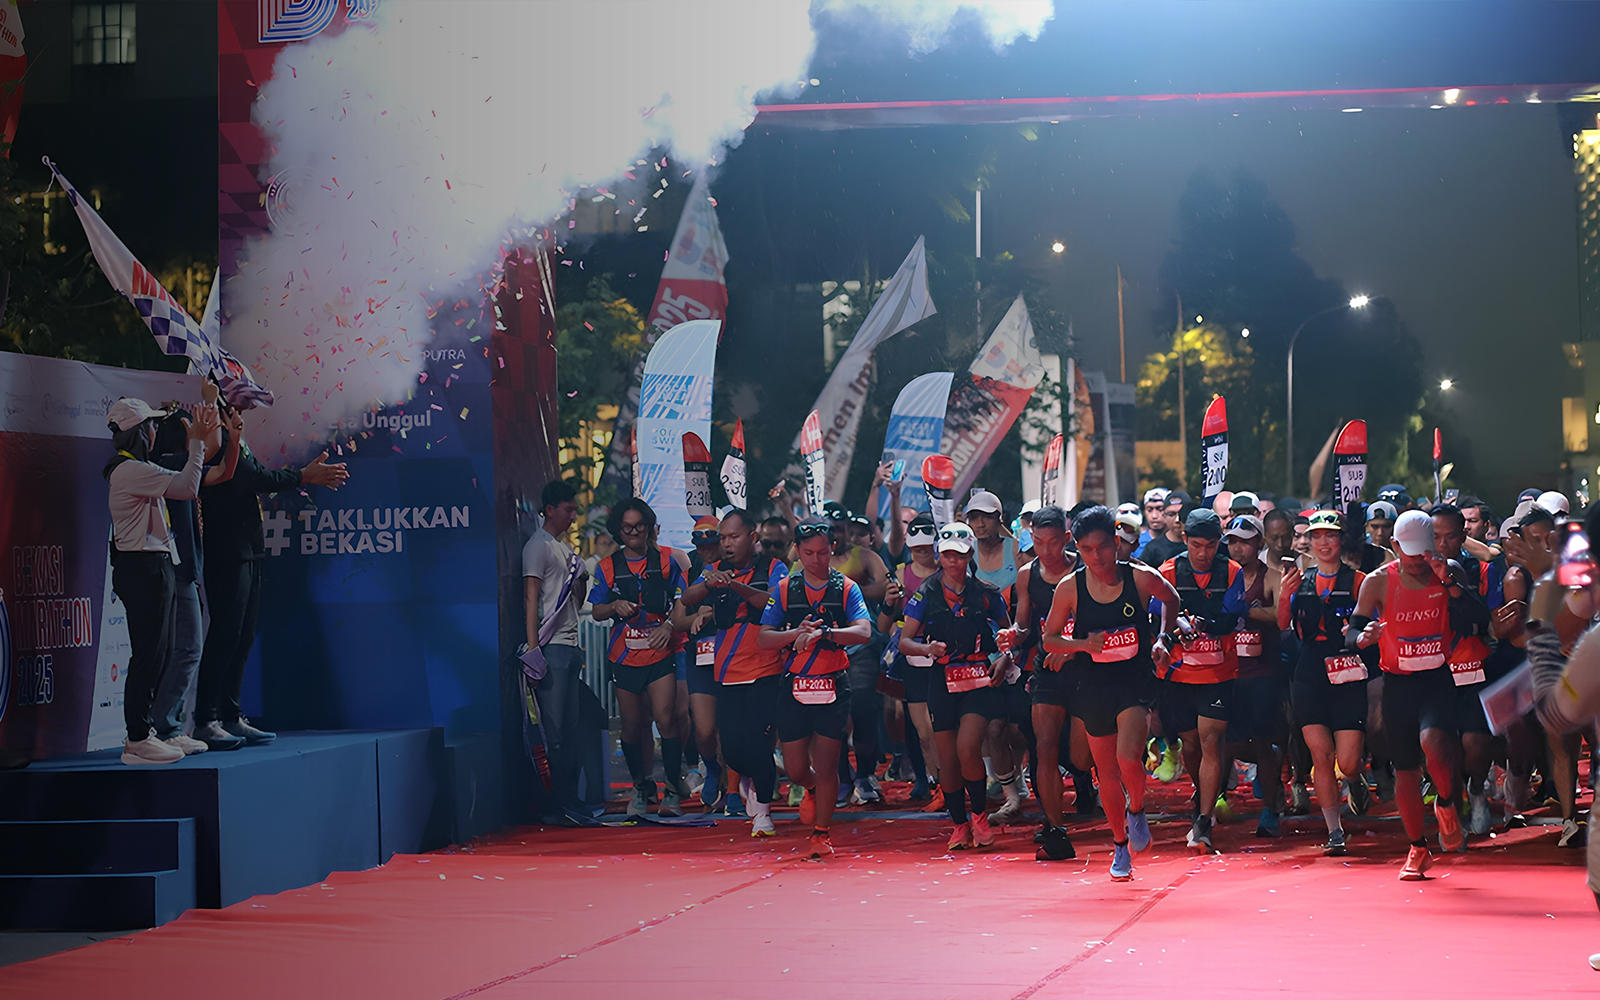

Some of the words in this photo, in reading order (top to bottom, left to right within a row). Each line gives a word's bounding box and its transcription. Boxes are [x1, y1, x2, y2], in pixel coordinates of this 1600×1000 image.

[363, 409, 431, 432] Unggul
[686, 490, 711, 507] 2:30
[300, 505, 470, 531] TAKLUKKAN
[300, 531, 403, 555] BEKASI
[1396, 607, 1440, 622] DENSO
[1104, 631, 1136, 647] -20153
[17, 654, 54, 706] 2025
